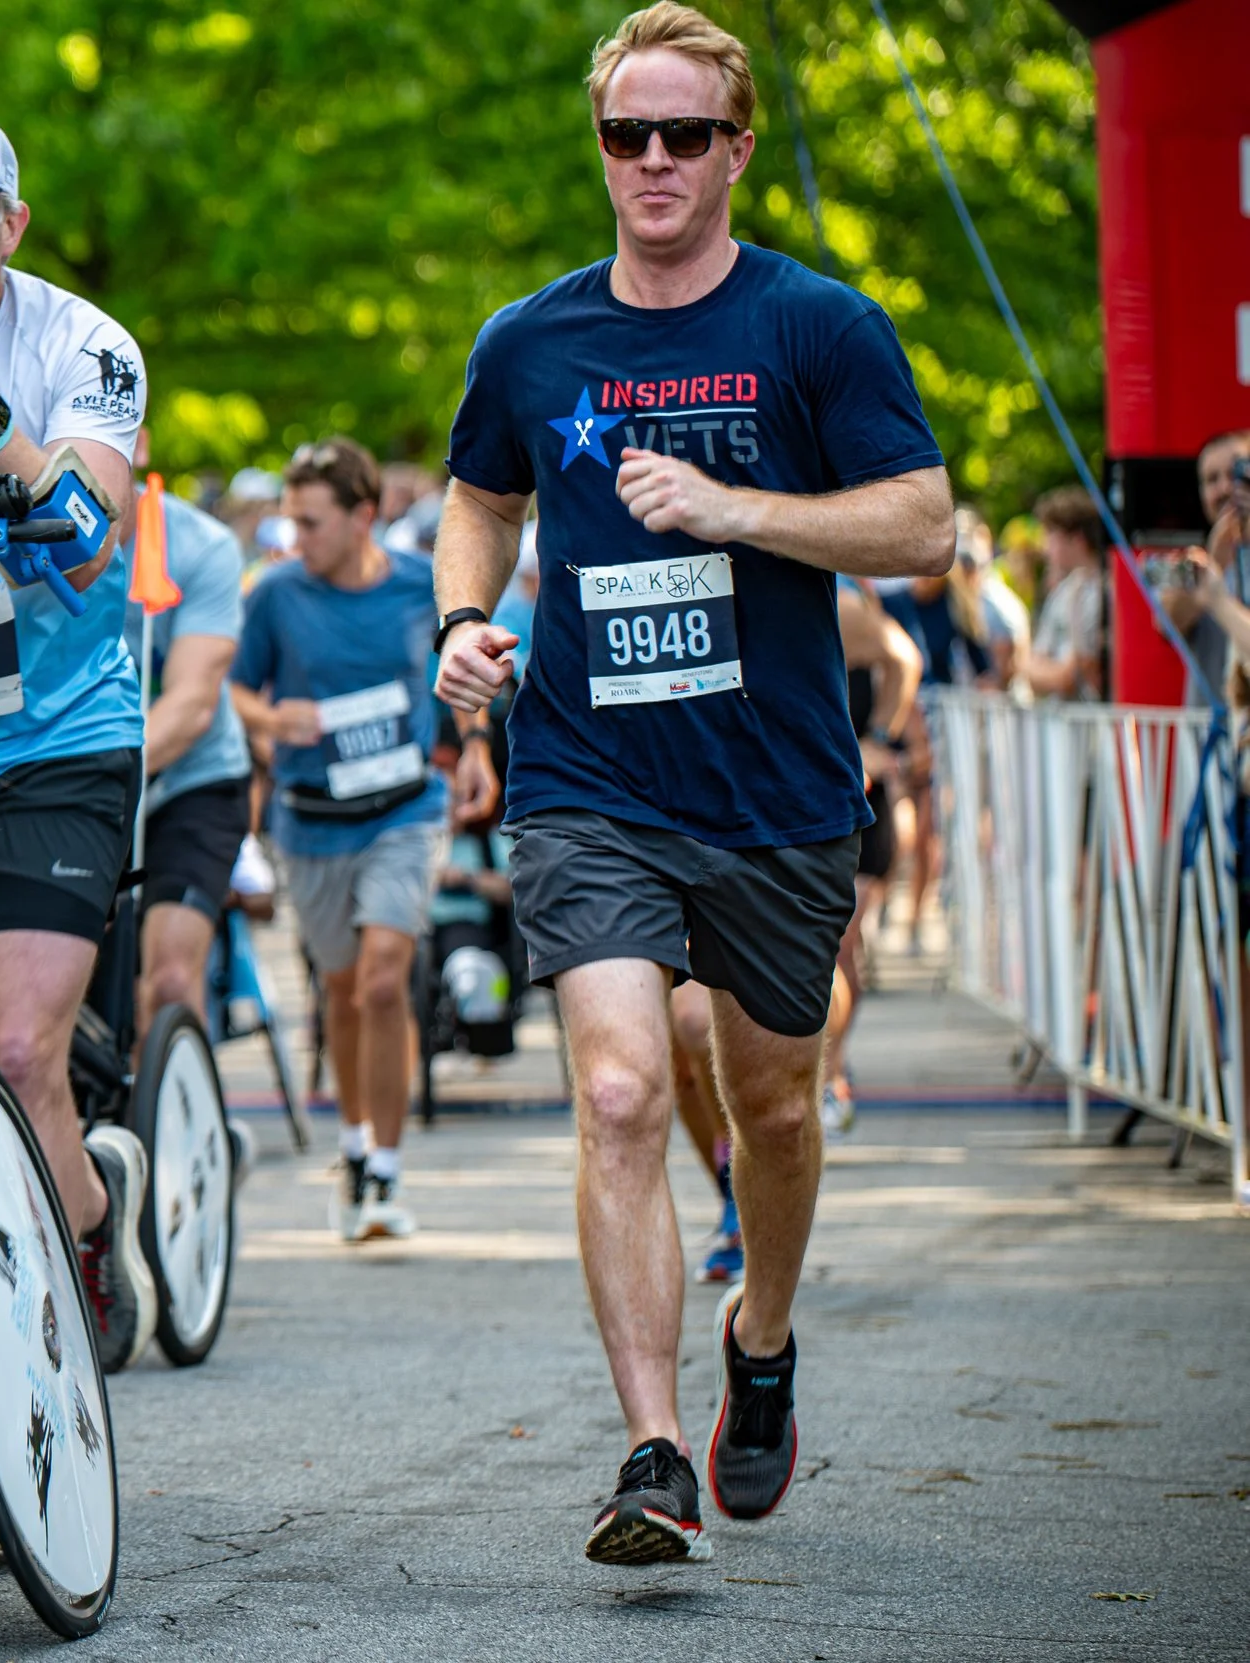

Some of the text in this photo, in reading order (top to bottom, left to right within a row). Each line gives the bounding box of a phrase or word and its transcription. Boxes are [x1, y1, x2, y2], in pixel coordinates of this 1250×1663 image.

[601, 373, 757, 408] INSPIRED
[625, 419, 759, 464] VETS
[595, 561, 713, 598] SPARK 5K
[607, 609, 712, 666] 9948
[610, 688, 641, 697] ROARK
